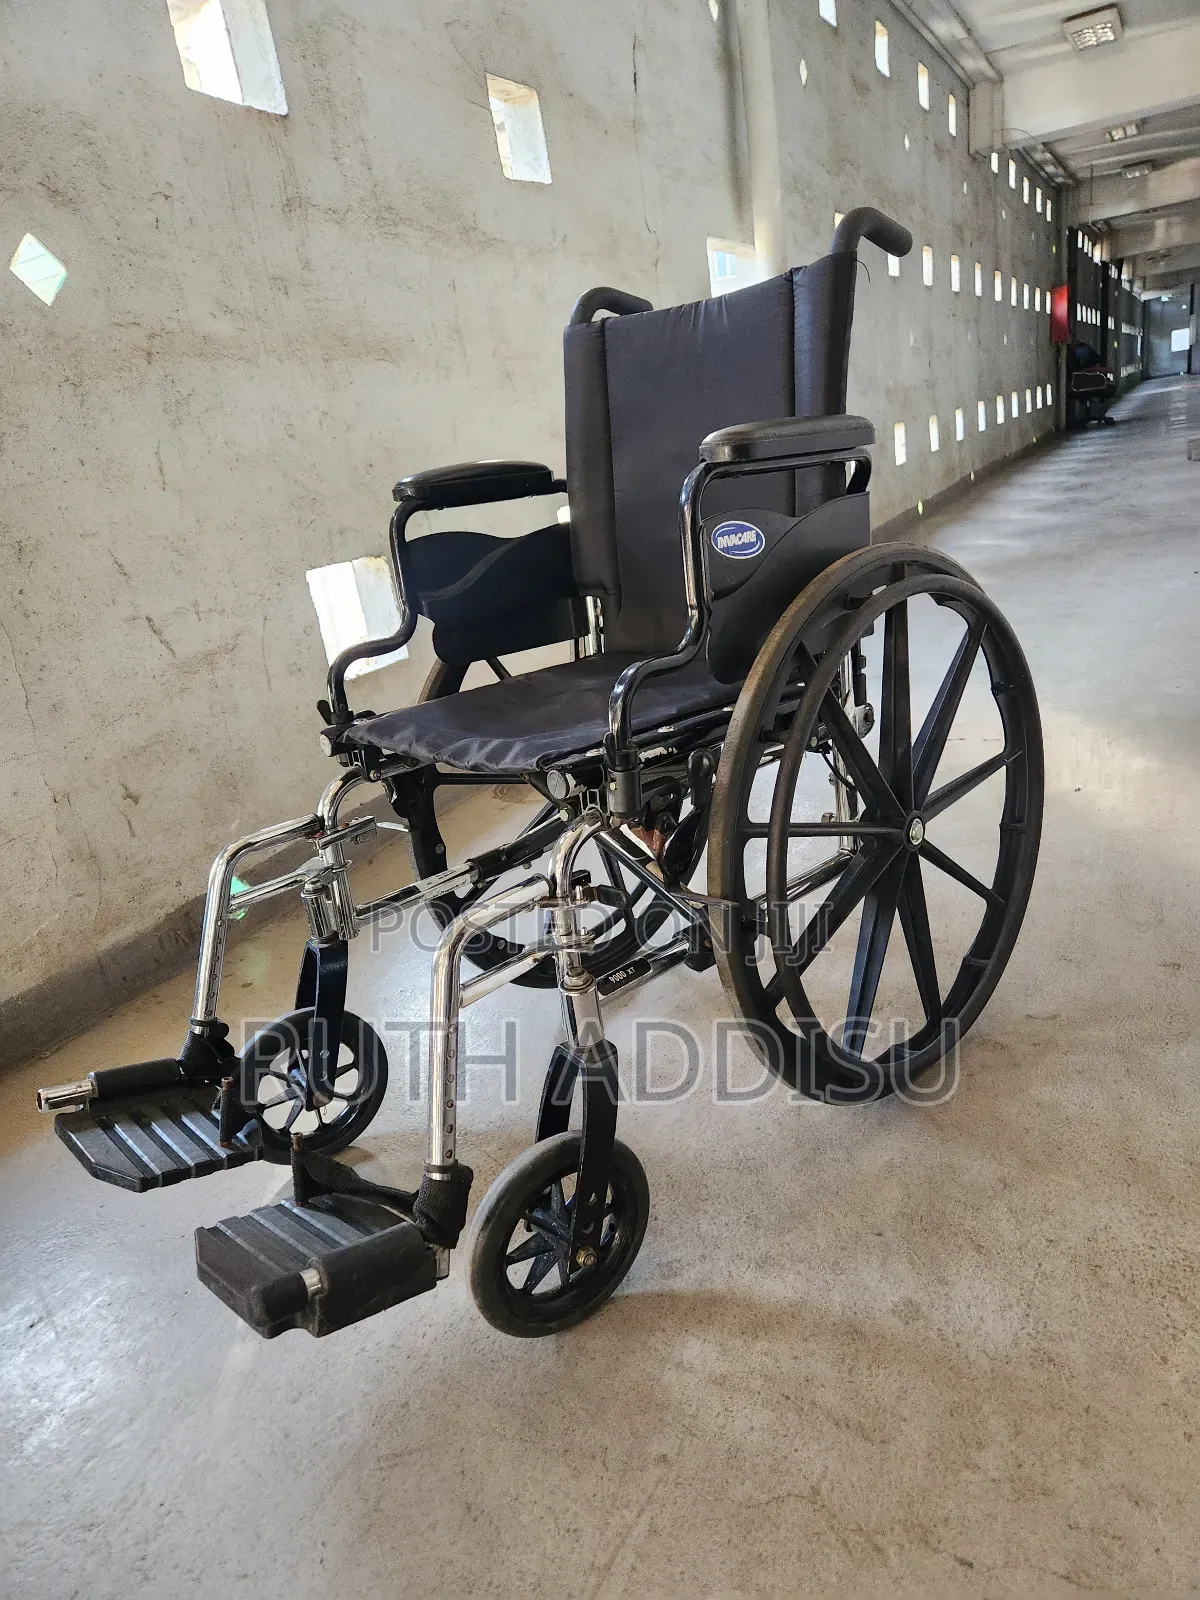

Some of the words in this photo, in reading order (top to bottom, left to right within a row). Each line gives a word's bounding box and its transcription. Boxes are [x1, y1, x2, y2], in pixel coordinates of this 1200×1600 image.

[717, 530, 756, 548] INVACARE
[608, 970, 627, 984] 9000
[627, 966, 636, 975] XT
